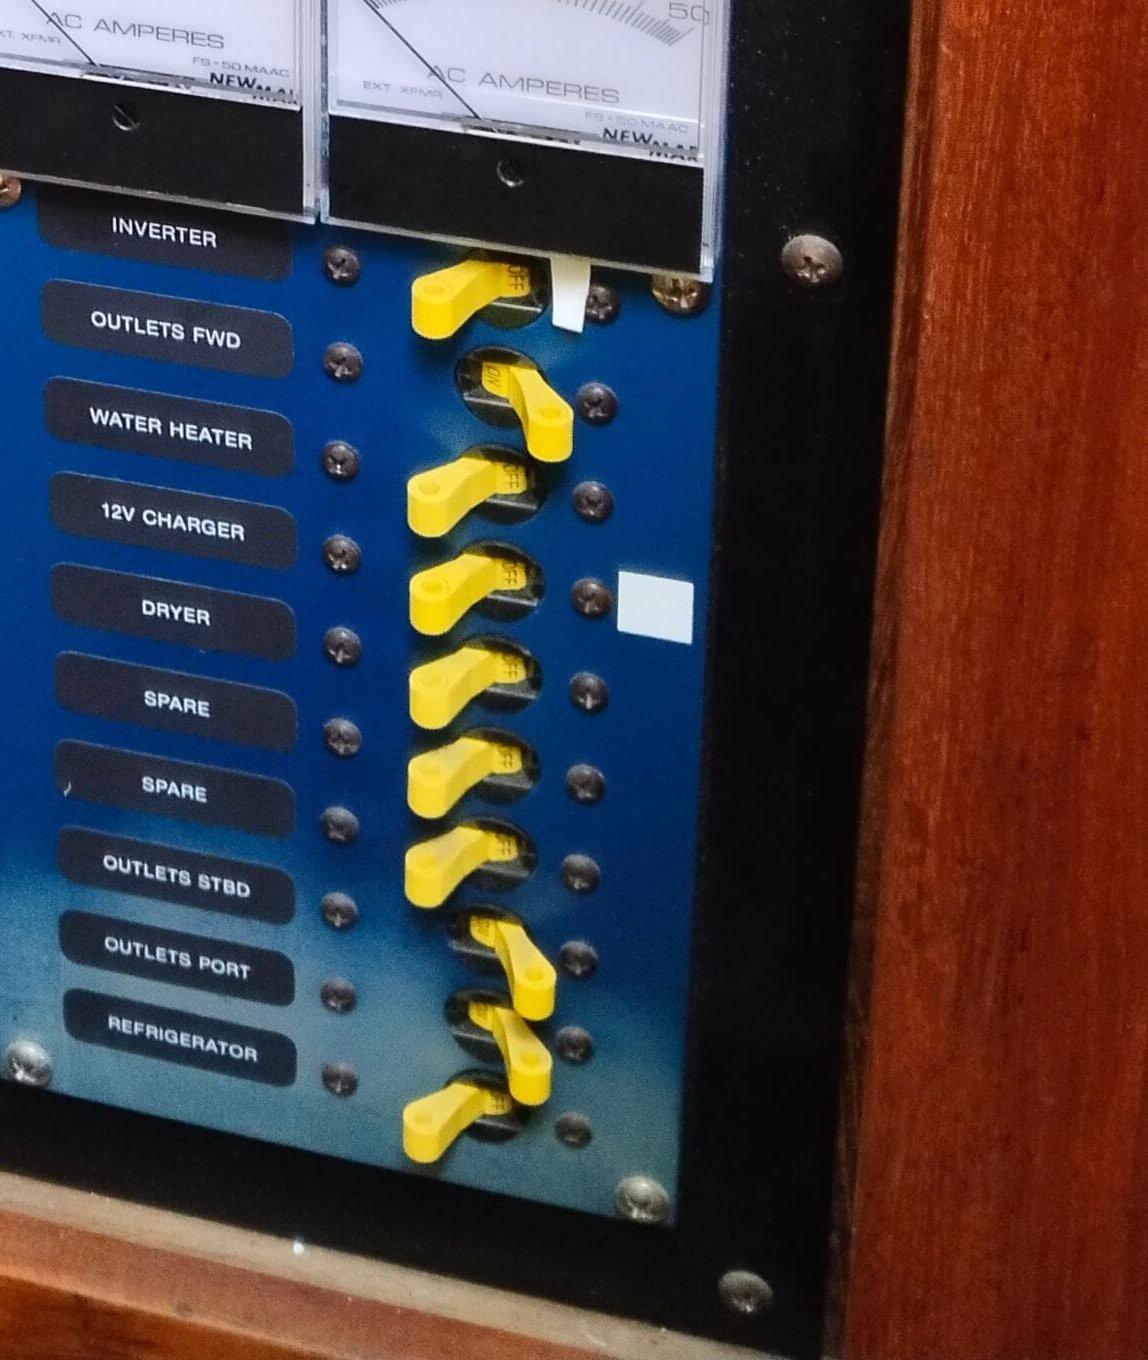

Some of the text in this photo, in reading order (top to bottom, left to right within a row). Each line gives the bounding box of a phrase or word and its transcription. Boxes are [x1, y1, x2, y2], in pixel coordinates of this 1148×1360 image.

[668, 3, 710, 23] 50
[94, 15, 224, 49] AMPERES
[479, 72, 619, 104] AMPERES
[111, 217, 217, 249] INVERTER
[90, 311, 241, 350] OUTLETS FWD
[89, 407, 252, 451] WATER HEATER
[101, 502, 246, 541] 12V CHARGER
[141, 600, 211, 626] DRYER
[143, 691, 211, 719] SPARE
[141, 777, 207, 802] SPARE
[102, 855, 251, 898] OUTLETS STBD
[104, 937, 251, 980] OUTLETS PORT
[107, 1016, 257, 1062] REFRIGERATOR
